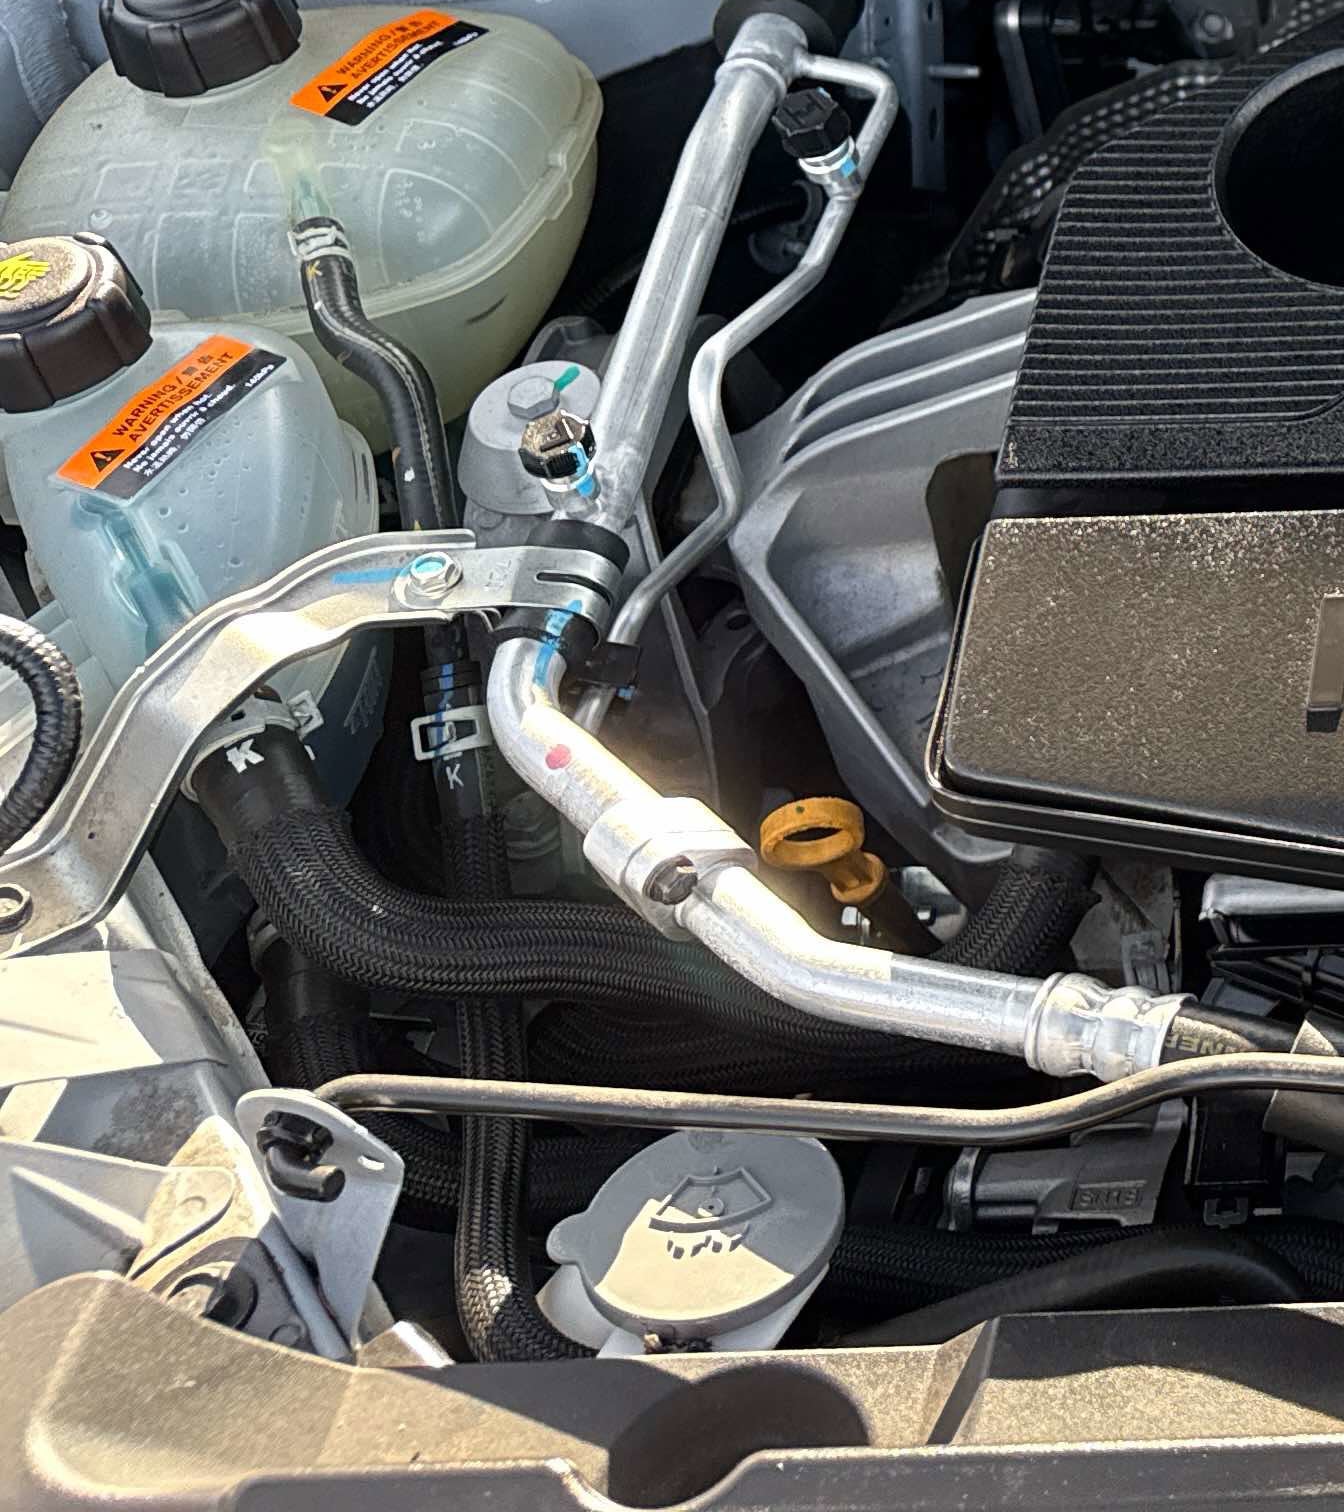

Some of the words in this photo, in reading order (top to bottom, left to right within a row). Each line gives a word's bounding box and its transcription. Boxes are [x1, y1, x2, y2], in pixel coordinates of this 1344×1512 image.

[336, 34, 392, 75] WARNING
[112, 384, 177, 436] WARNING
[129, 352, 233, 442] AVERTISSEMENT
[446, 763, 464, 790] K
